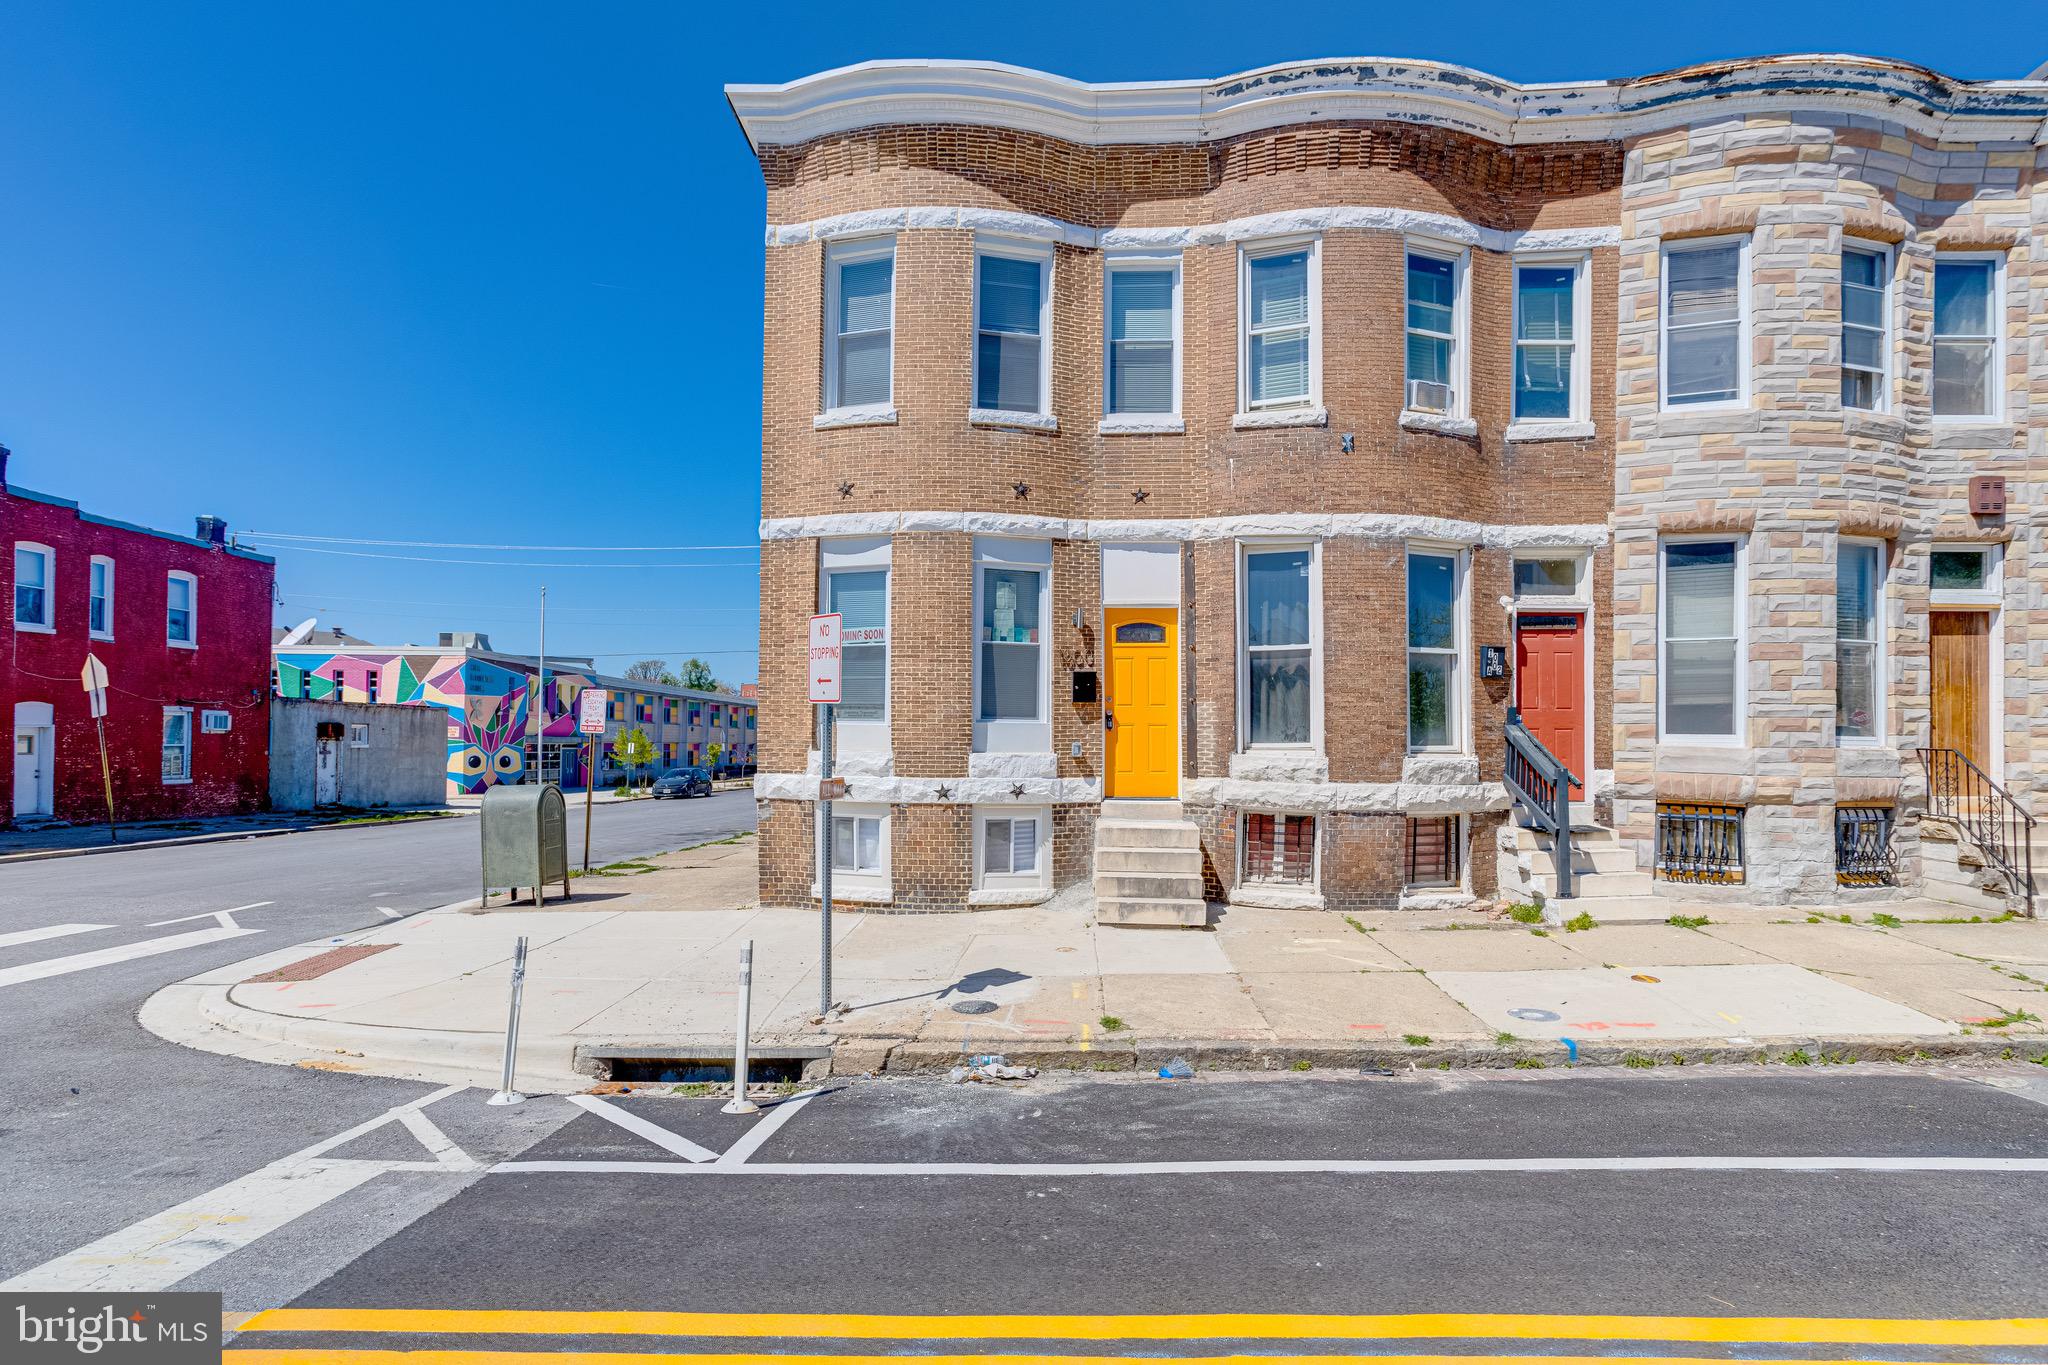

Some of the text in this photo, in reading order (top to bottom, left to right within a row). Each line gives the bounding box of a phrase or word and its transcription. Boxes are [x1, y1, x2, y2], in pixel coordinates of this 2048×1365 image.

[819, 624, 830, 637] NO
[841, 629, 884, 641] OMING SOON
[811, 646, 839, 660] STOPPING
